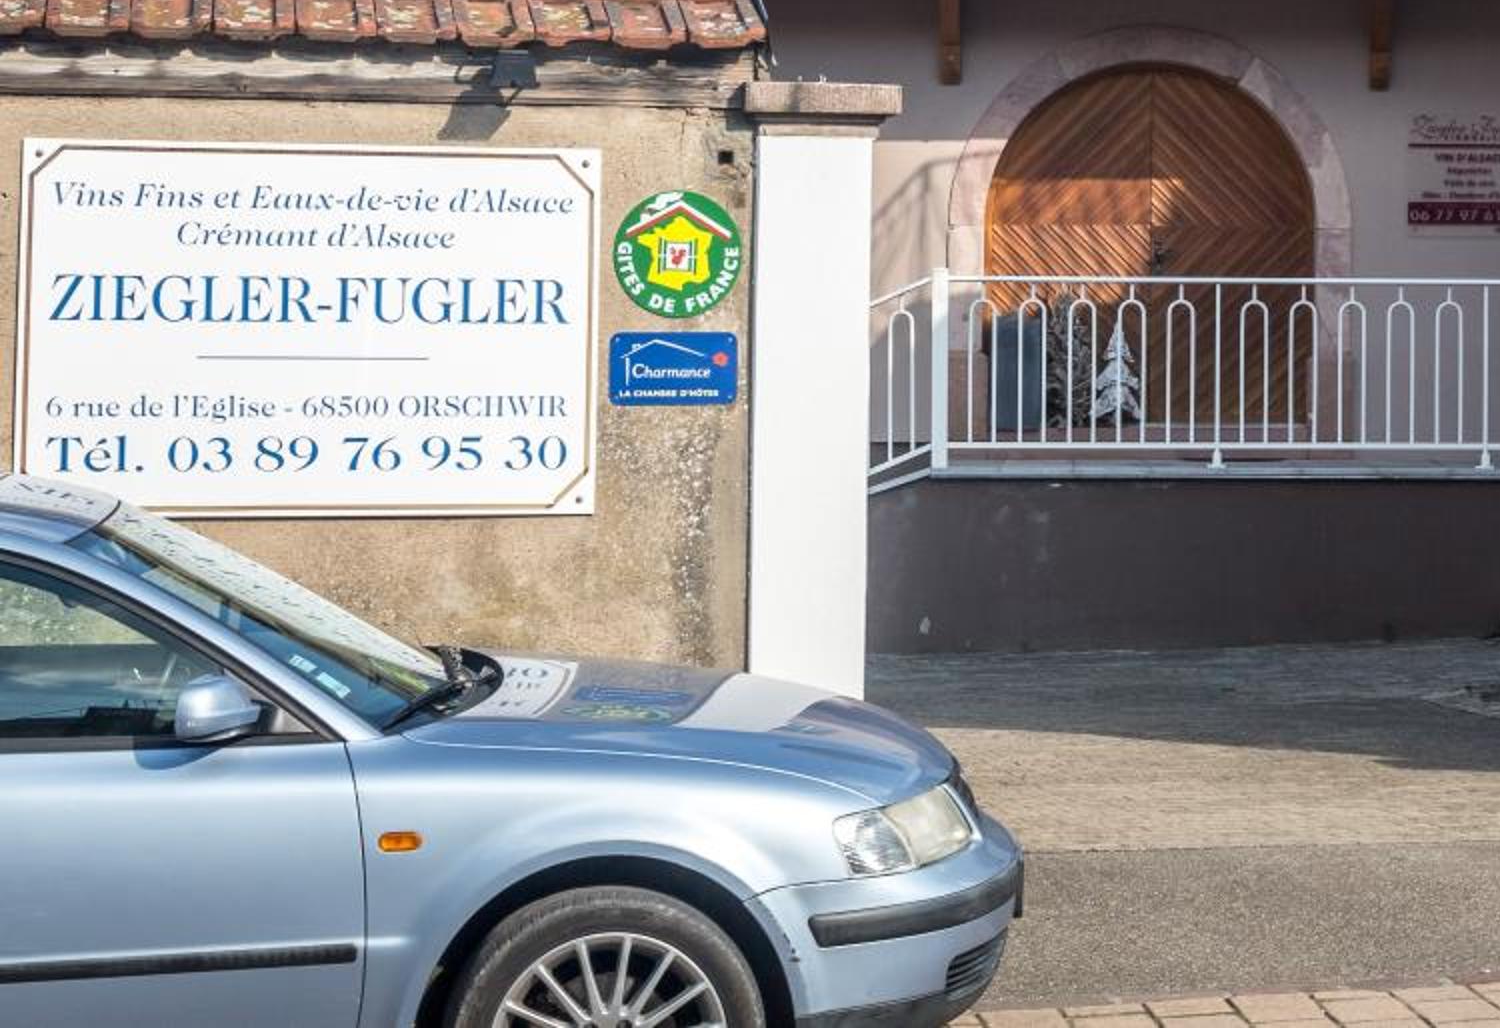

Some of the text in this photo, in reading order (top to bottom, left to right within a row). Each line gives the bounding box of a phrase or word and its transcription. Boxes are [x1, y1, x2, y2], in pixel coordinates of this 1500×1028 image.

[54, 181, 575, 214] Vins Fins et Eaux-de-vie d'Alsace
[176, 221, 455, 249] Crémant d'Alsace
[617, 241, 740, 313] GITES DE FRANCE
[48, 273, 569, 325] ZIEGLER-FUGLER
[631, 363, 711, 379] Charmance
[45, 395, 63, 417] 6
[72, 400, 121, 418] rue
[129, 394, 164, 418] de
[173, 394, 276, 422] l'Eglise
[301, 395, 389, 418] 68500
[398, 395, 567, 418] ORSCHWIR
[618, 389, 632, 398] LA
[45, 435, 568, 473] Tél. 03 89 76 95 30
